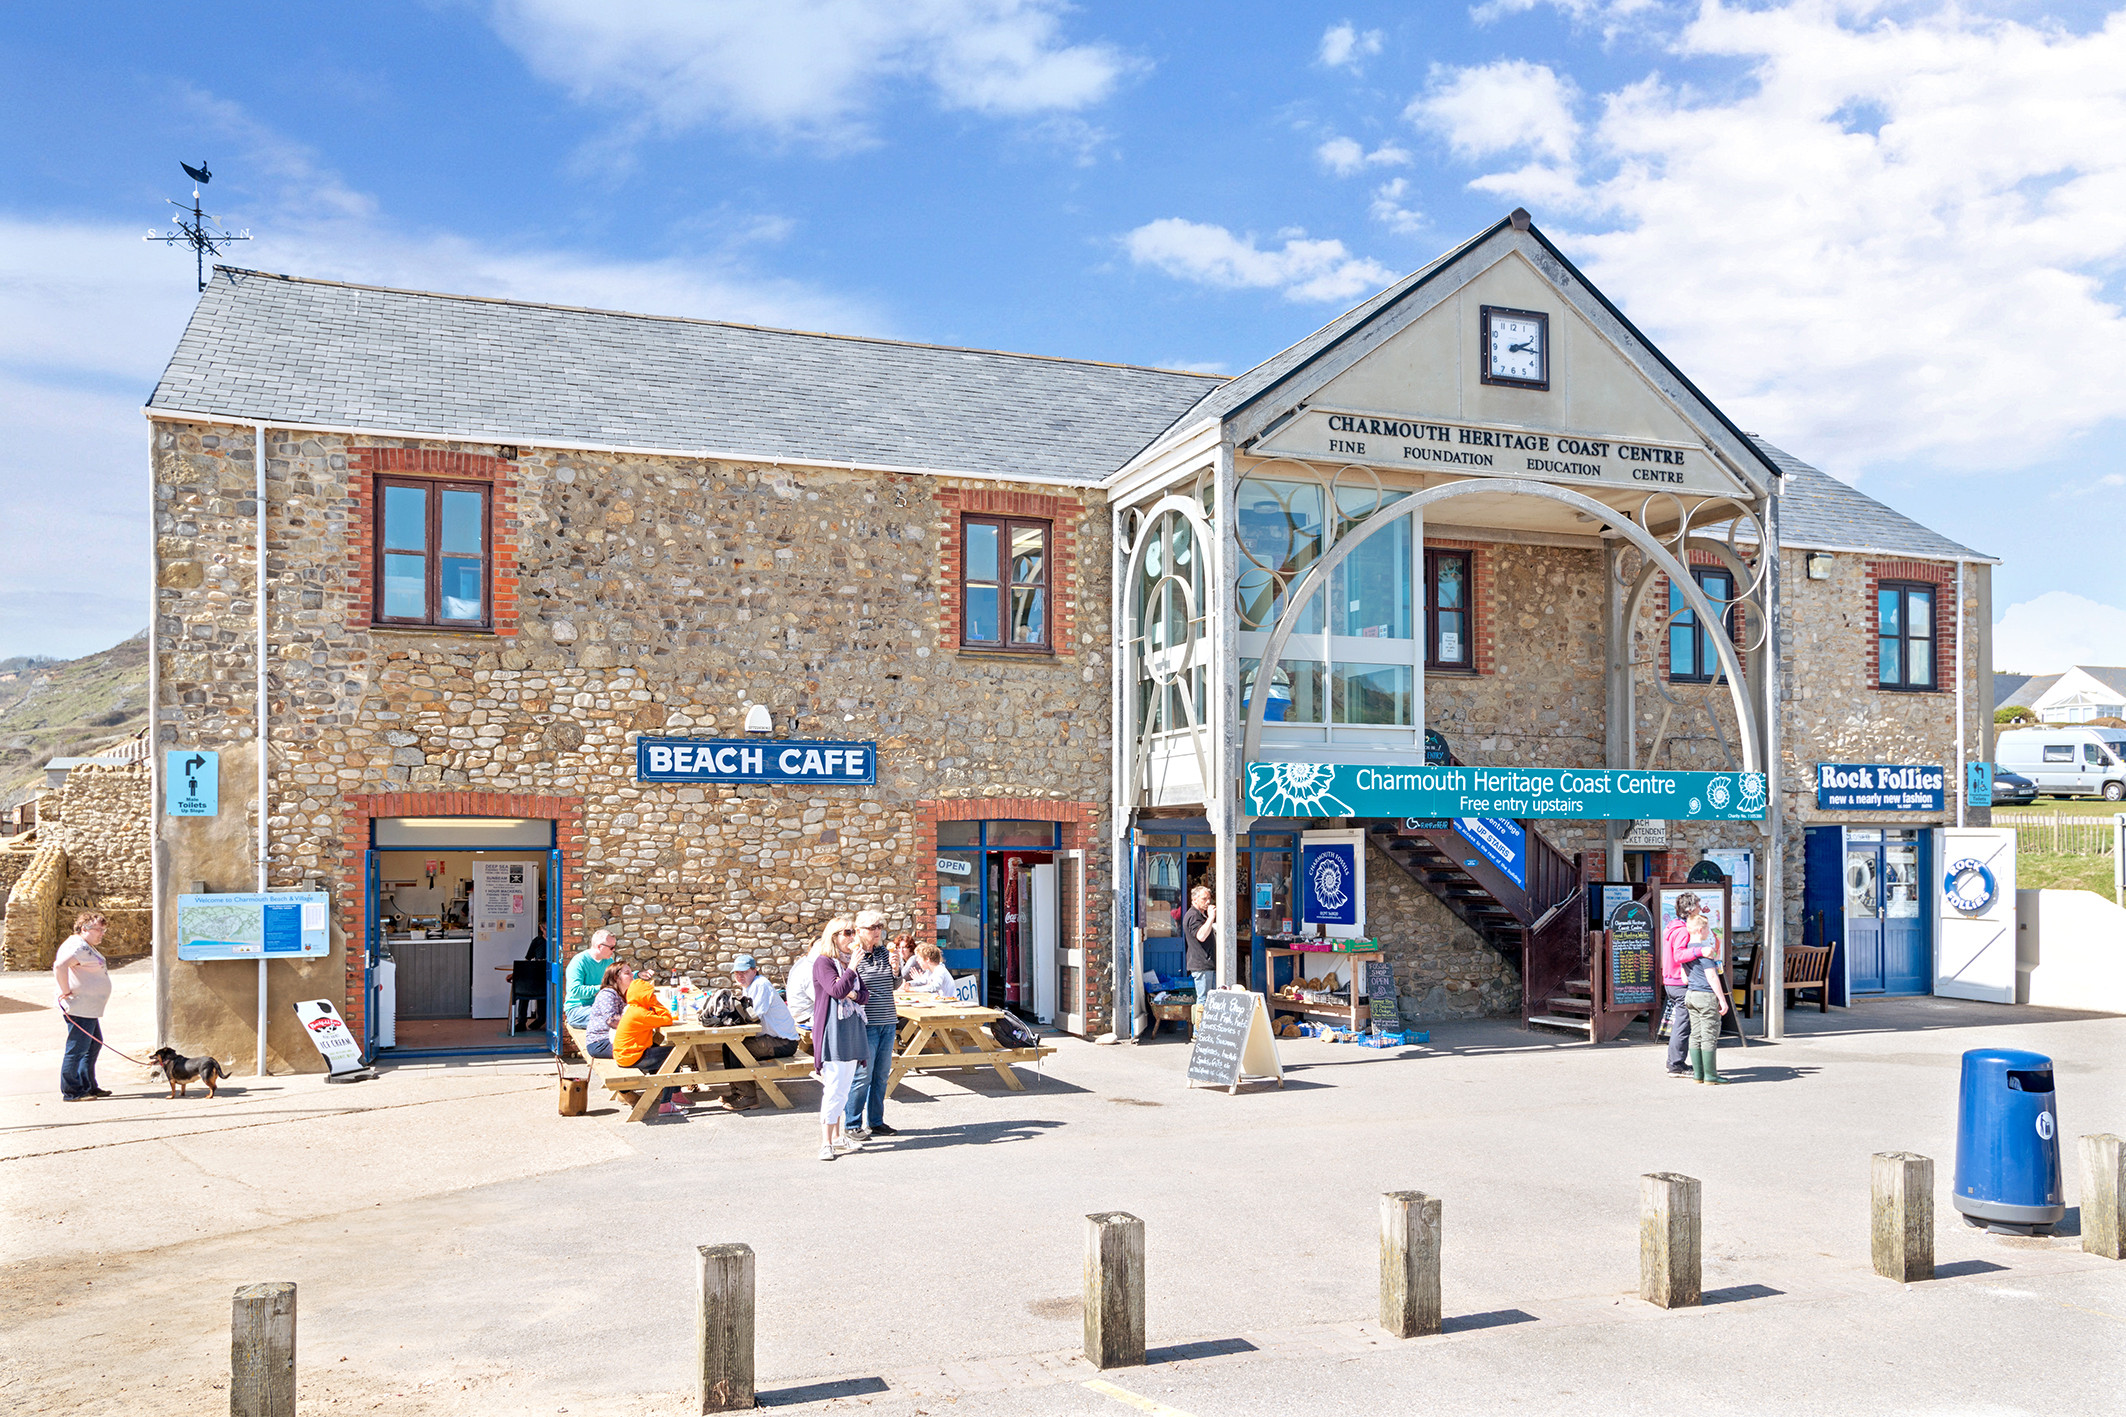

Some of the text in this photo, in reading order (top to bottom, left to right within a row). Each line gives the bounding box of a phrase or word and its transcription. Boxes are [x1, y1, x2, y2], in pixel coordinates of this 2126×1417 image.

[1492, 330, 1498, 338] 10
[1530, 335, 1534, 343] 2
[1328, 416, 1684, 465] CHARMOUTH HERITAGE COAST CENTRE
[1329, 440, 1684, 484] FINE FOUNDATION EDUCATION CENTRE
[648, 746, 864, 775] BEACH CAFE
[1427, 752, 1444, 760] ENTRY
[1356, 769, 1676, 797] Charmouth Heritage Coast Centre
[1822, 766, 1942, 790] Rock Follies
[1460, 796, 1583, 814] Free entry upstairs
[1829, 792, 1932, 806] new & nearly new fashion
[1498, 818, 1520, 836] eritage
[1477, 825, 1510, 857] UP STAIRS
[938, 860, 966, 872] OPEN
[1309, 851, 1350, 876] CHARMOUTH FOSSILS
[1462, 829, 1475, 842] access
[1488, 851, 1496, 859] rear
[1507, 869, 1522, 884] building
[1948, 860, 1980, 876] ROCK
[1946, 890, 1990, 910] FOLLIES
[956, 980, 978, 1001] ach
[1209, 997, 1245, 1016] Beach Shop
[320, 1038, 352, 1049] ICE CREAM
